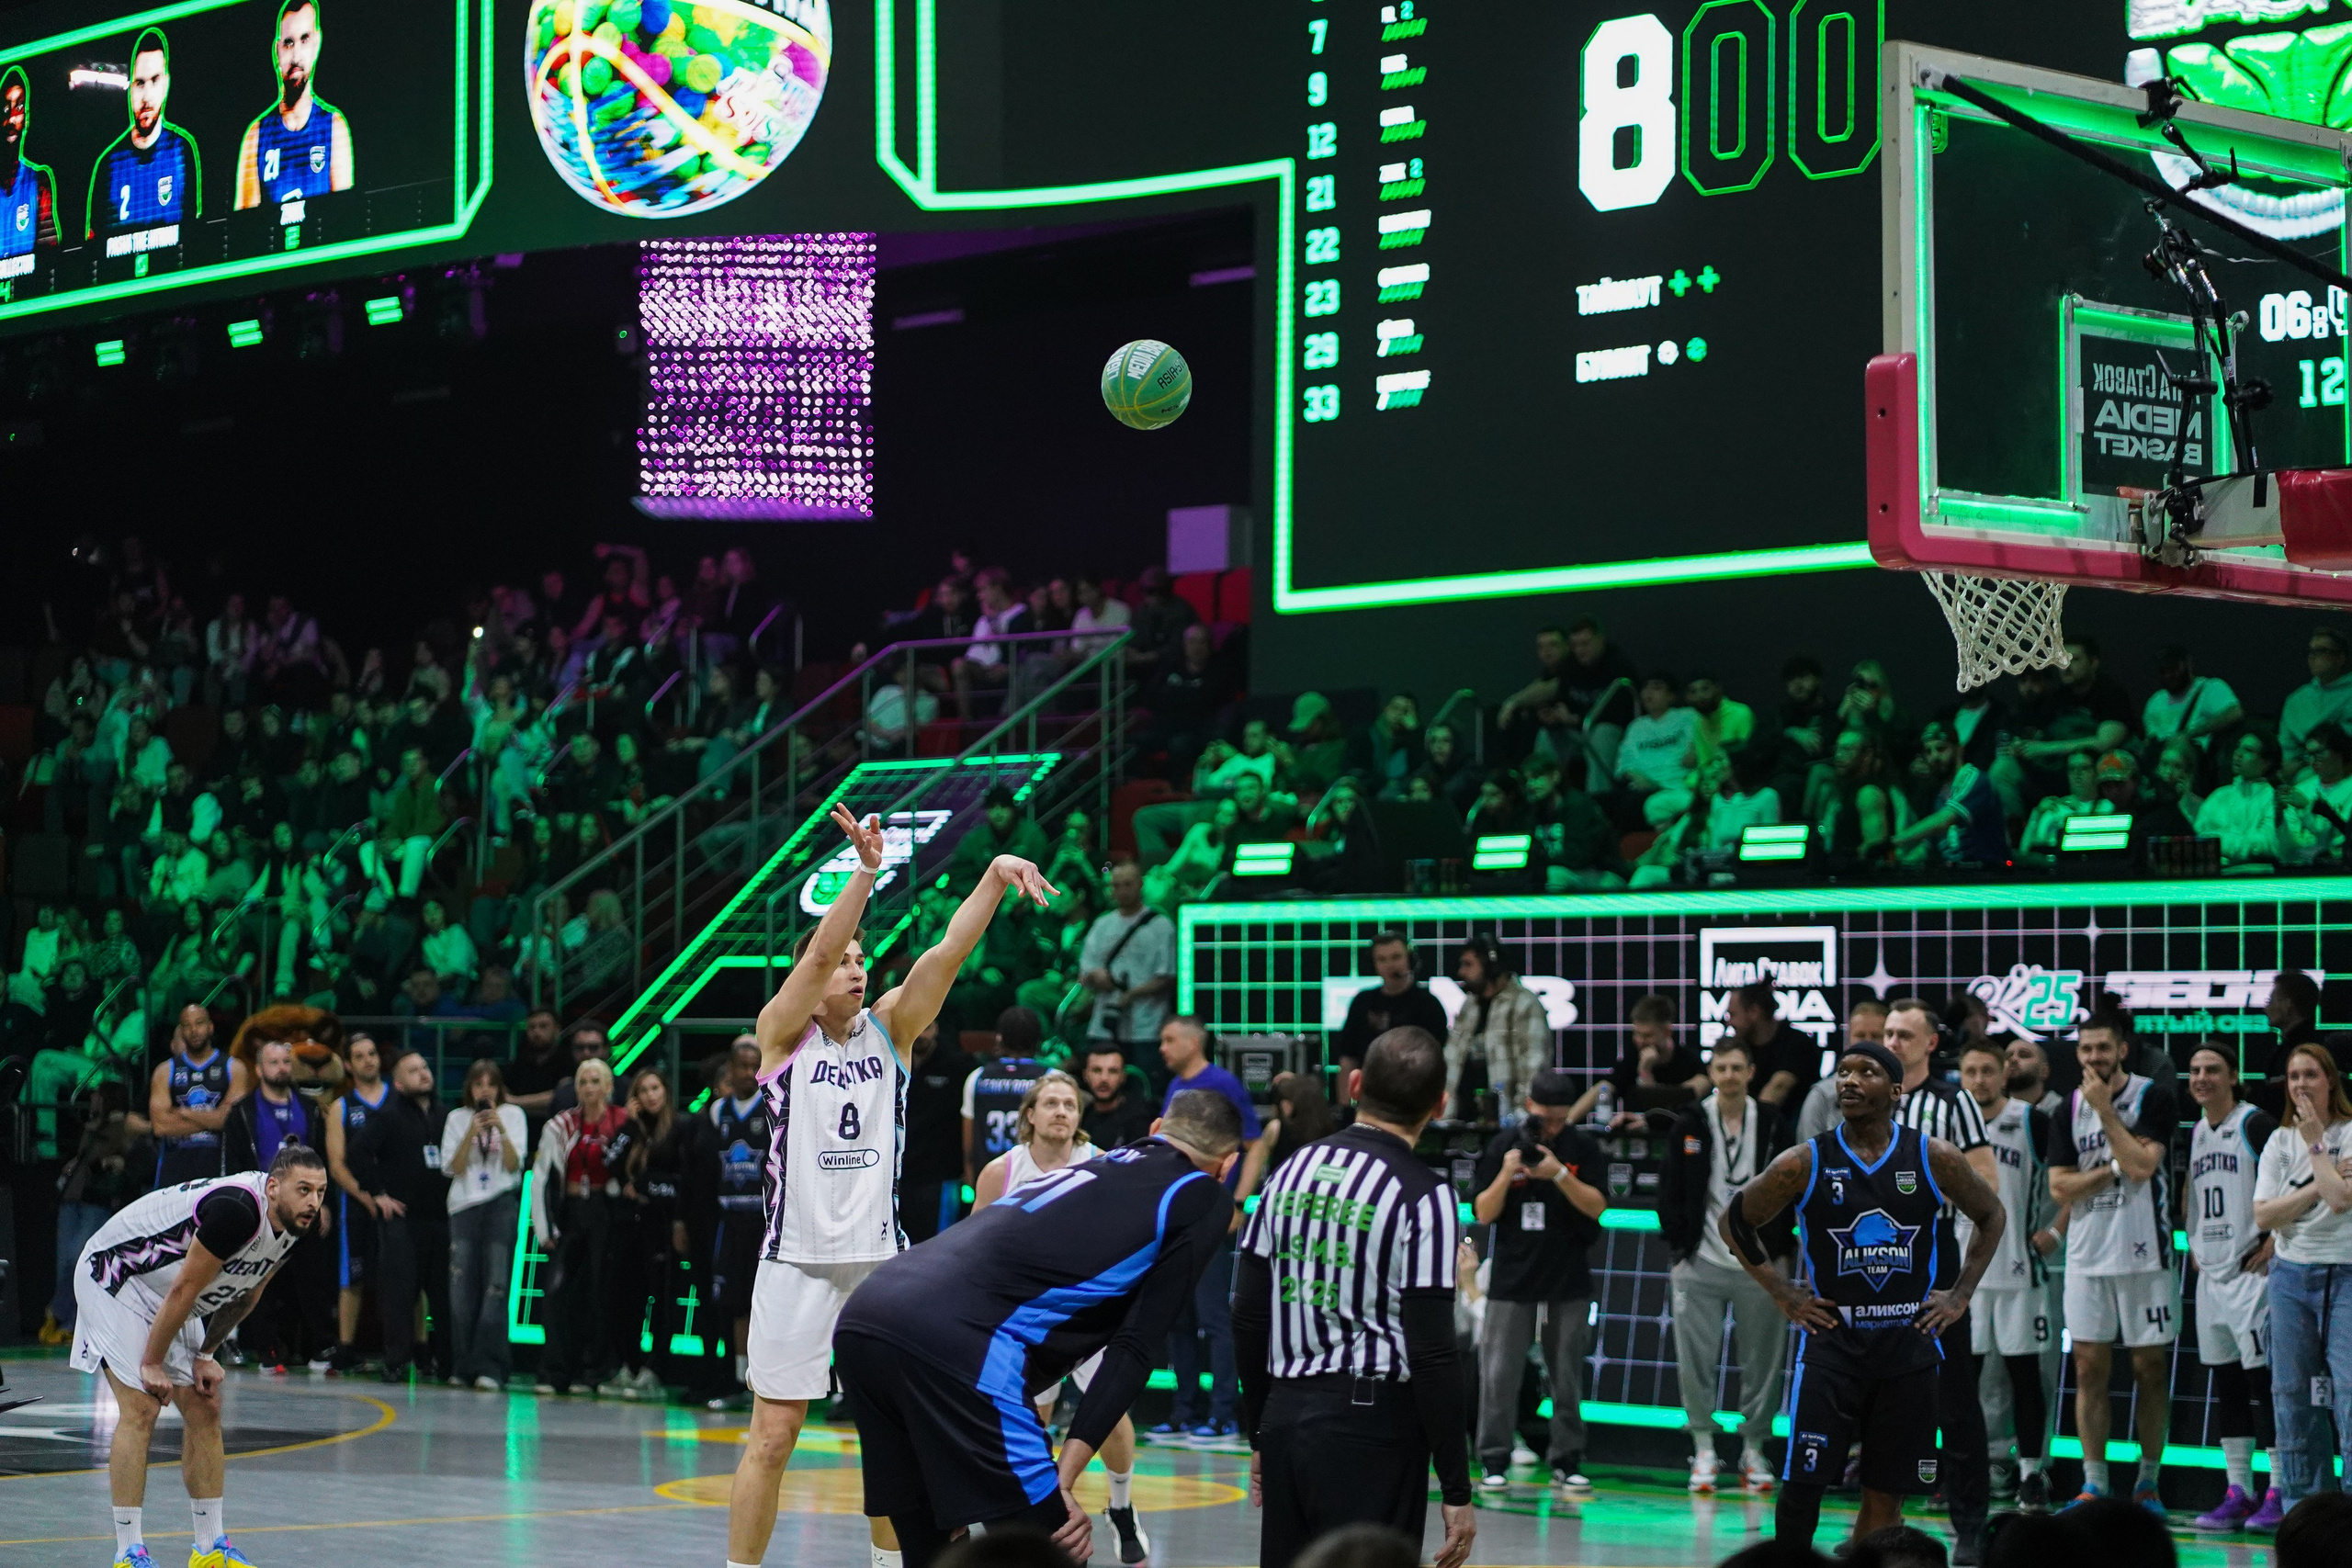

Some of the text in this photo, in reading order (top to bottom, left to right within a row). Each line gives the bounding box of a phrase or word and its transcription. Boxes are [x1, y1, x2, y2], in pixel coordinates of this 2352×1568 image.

[1308, 18, 1329, 55] 7
[1307, 71, 1329, 107] 9
[1306, 121, 1338, 161] 12
[119, 184, 130, 221] 2
[1306, 174, 1337, 213] 21
[1305, 226, 1340, 265] 22
[1304, 277, 1341, 318] 23
[1303, 383, 1341, 423] 33
[2023, 975, 2079, 1027] 25
[838, 1101, 861, 1141] 8
[822, 1155, 861, 1166] Winline
[990, 1168, 1098, 1214] 21
[1831, 1181, 1844, 1206] 3
[2204, 1186, 2224, 1219] 10
[1272, 1190, 1377, 1232] REFEREE
[1843, 1247, 1909, 1270] ALIKSON
[1867, 1266, 1888, 1274] TEAM
[1854, 1301, 1920, 1318] аликсон
[2033, 1314, 2050, 1342] 9
[1803, 1448, 1819, 1472] 3
